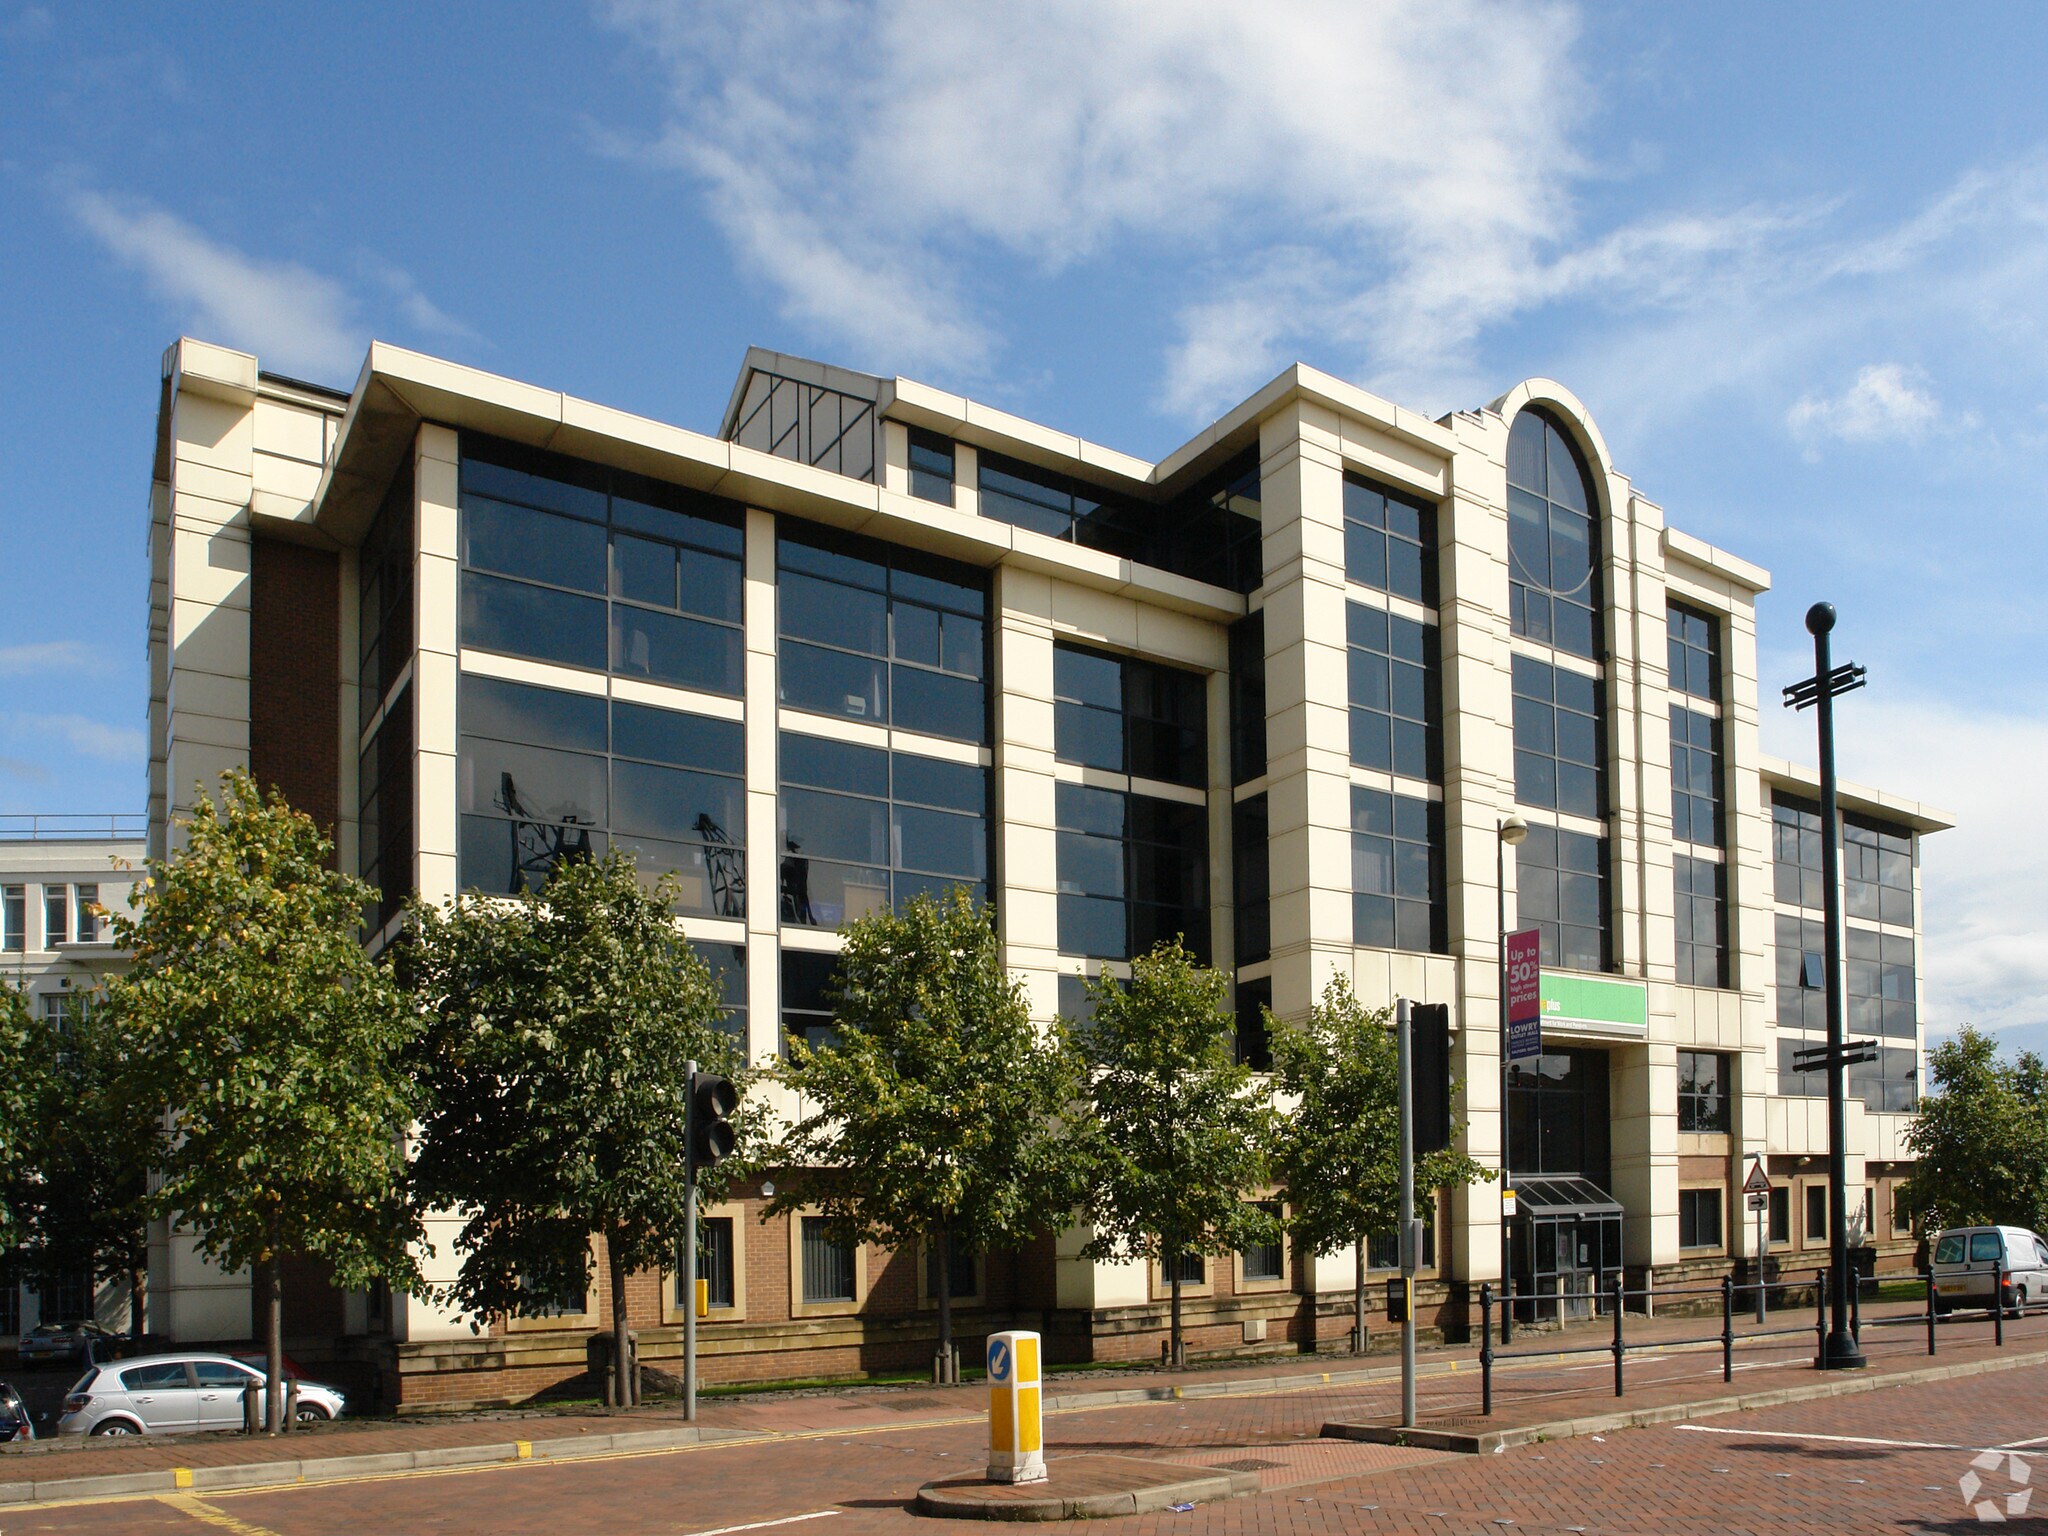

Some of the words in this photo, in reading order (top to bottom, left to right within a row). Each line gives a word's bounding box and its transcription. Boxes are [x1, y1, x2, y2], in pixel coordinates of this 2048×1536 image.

[1510, 950, 1524, 962] Up
[1527, 948, 1536, 957] to
[1511, 984, 1522, 993] high
[1511, 991, 1537, 1007] prices
[1510, 1021, 1538, 1035] LOWRY
